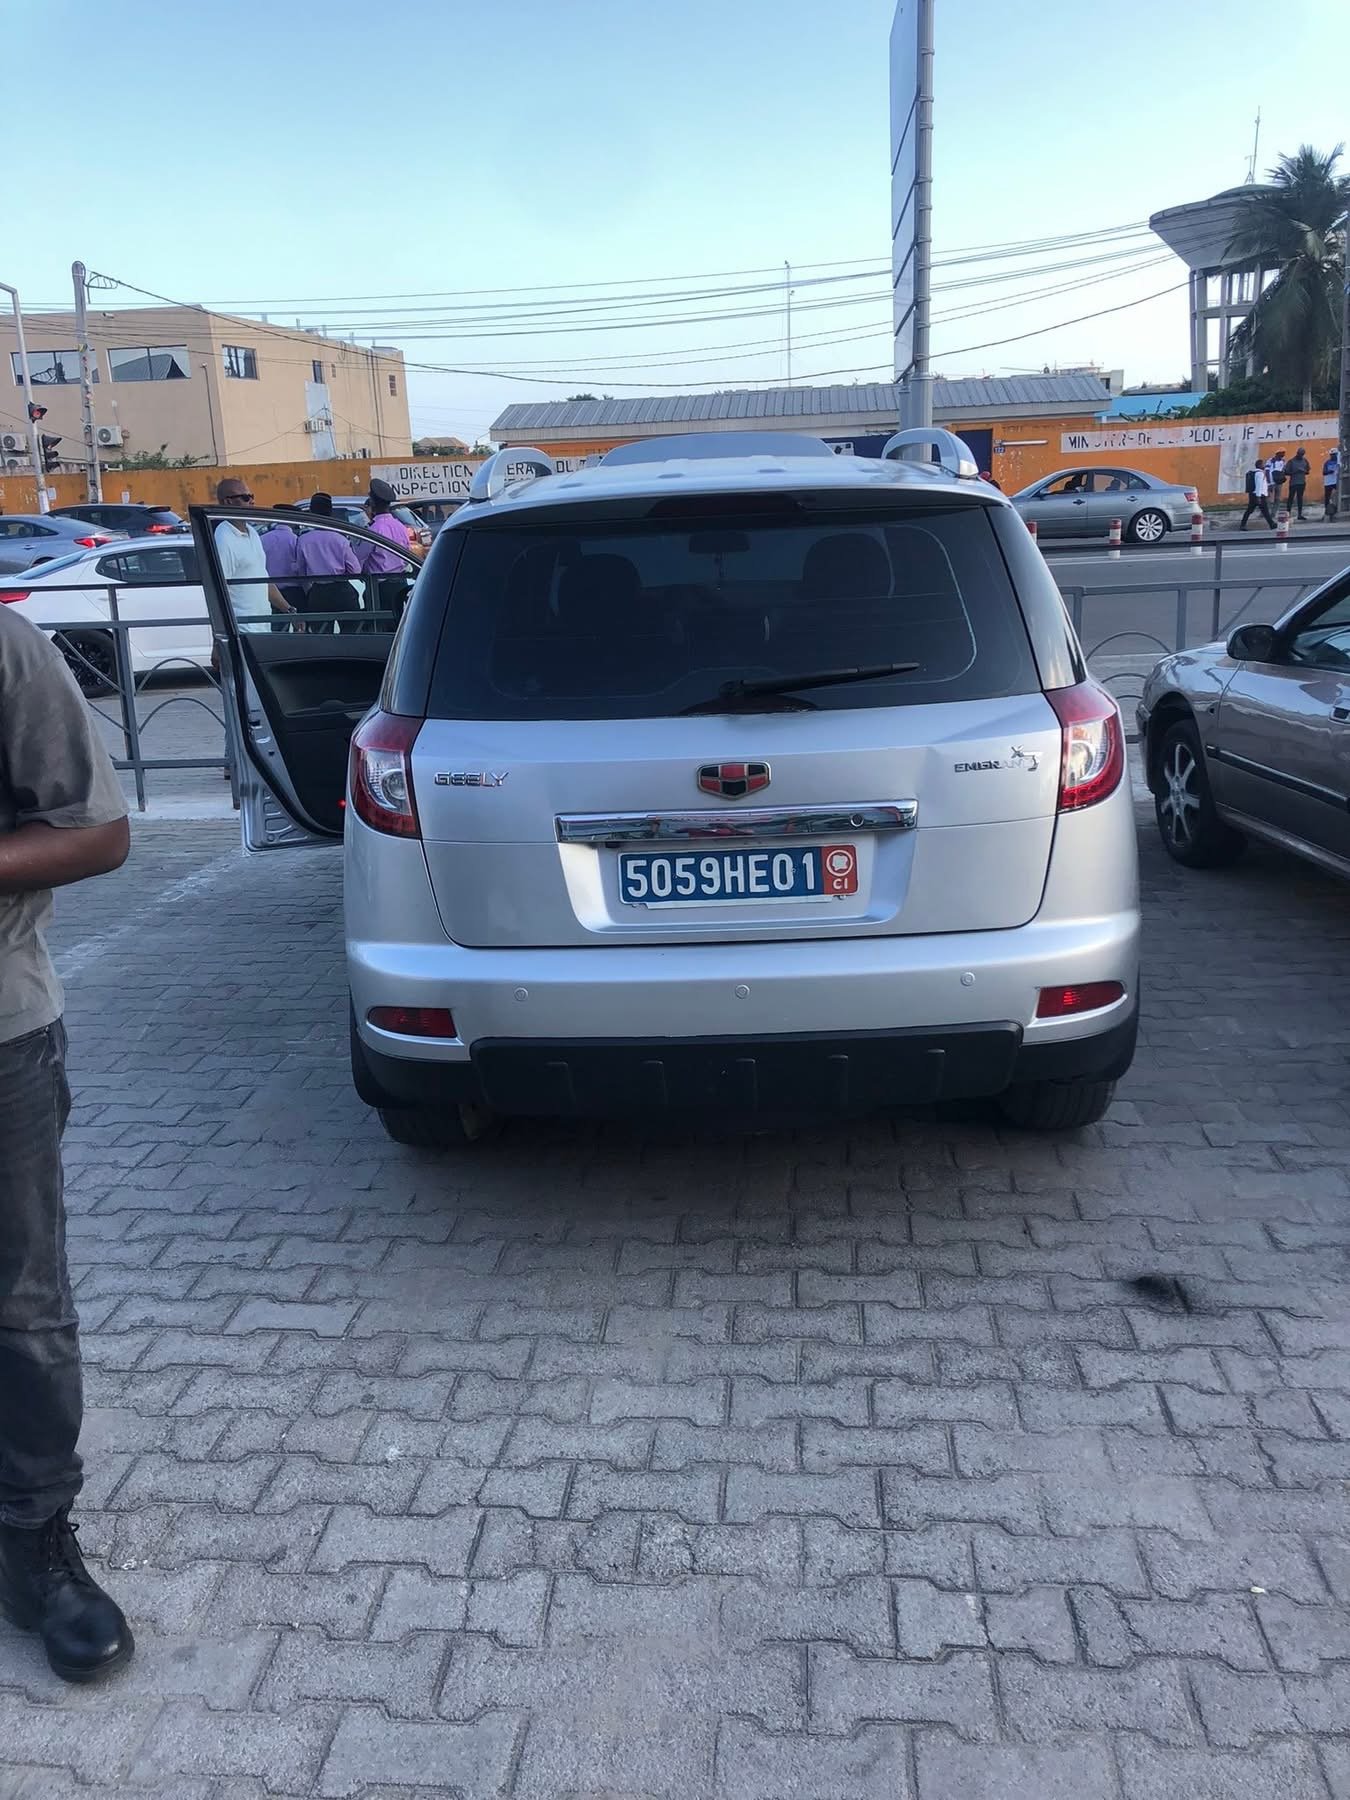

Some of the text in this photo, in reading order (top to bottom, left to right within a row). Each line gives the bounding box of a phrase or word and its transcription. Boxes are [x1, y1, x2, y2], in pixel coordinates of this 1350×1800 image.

[434, 771, 510, 788] GEELY
[626, 852, 815, 899] 5059HE01
[833, 877, 849, 890] CI
